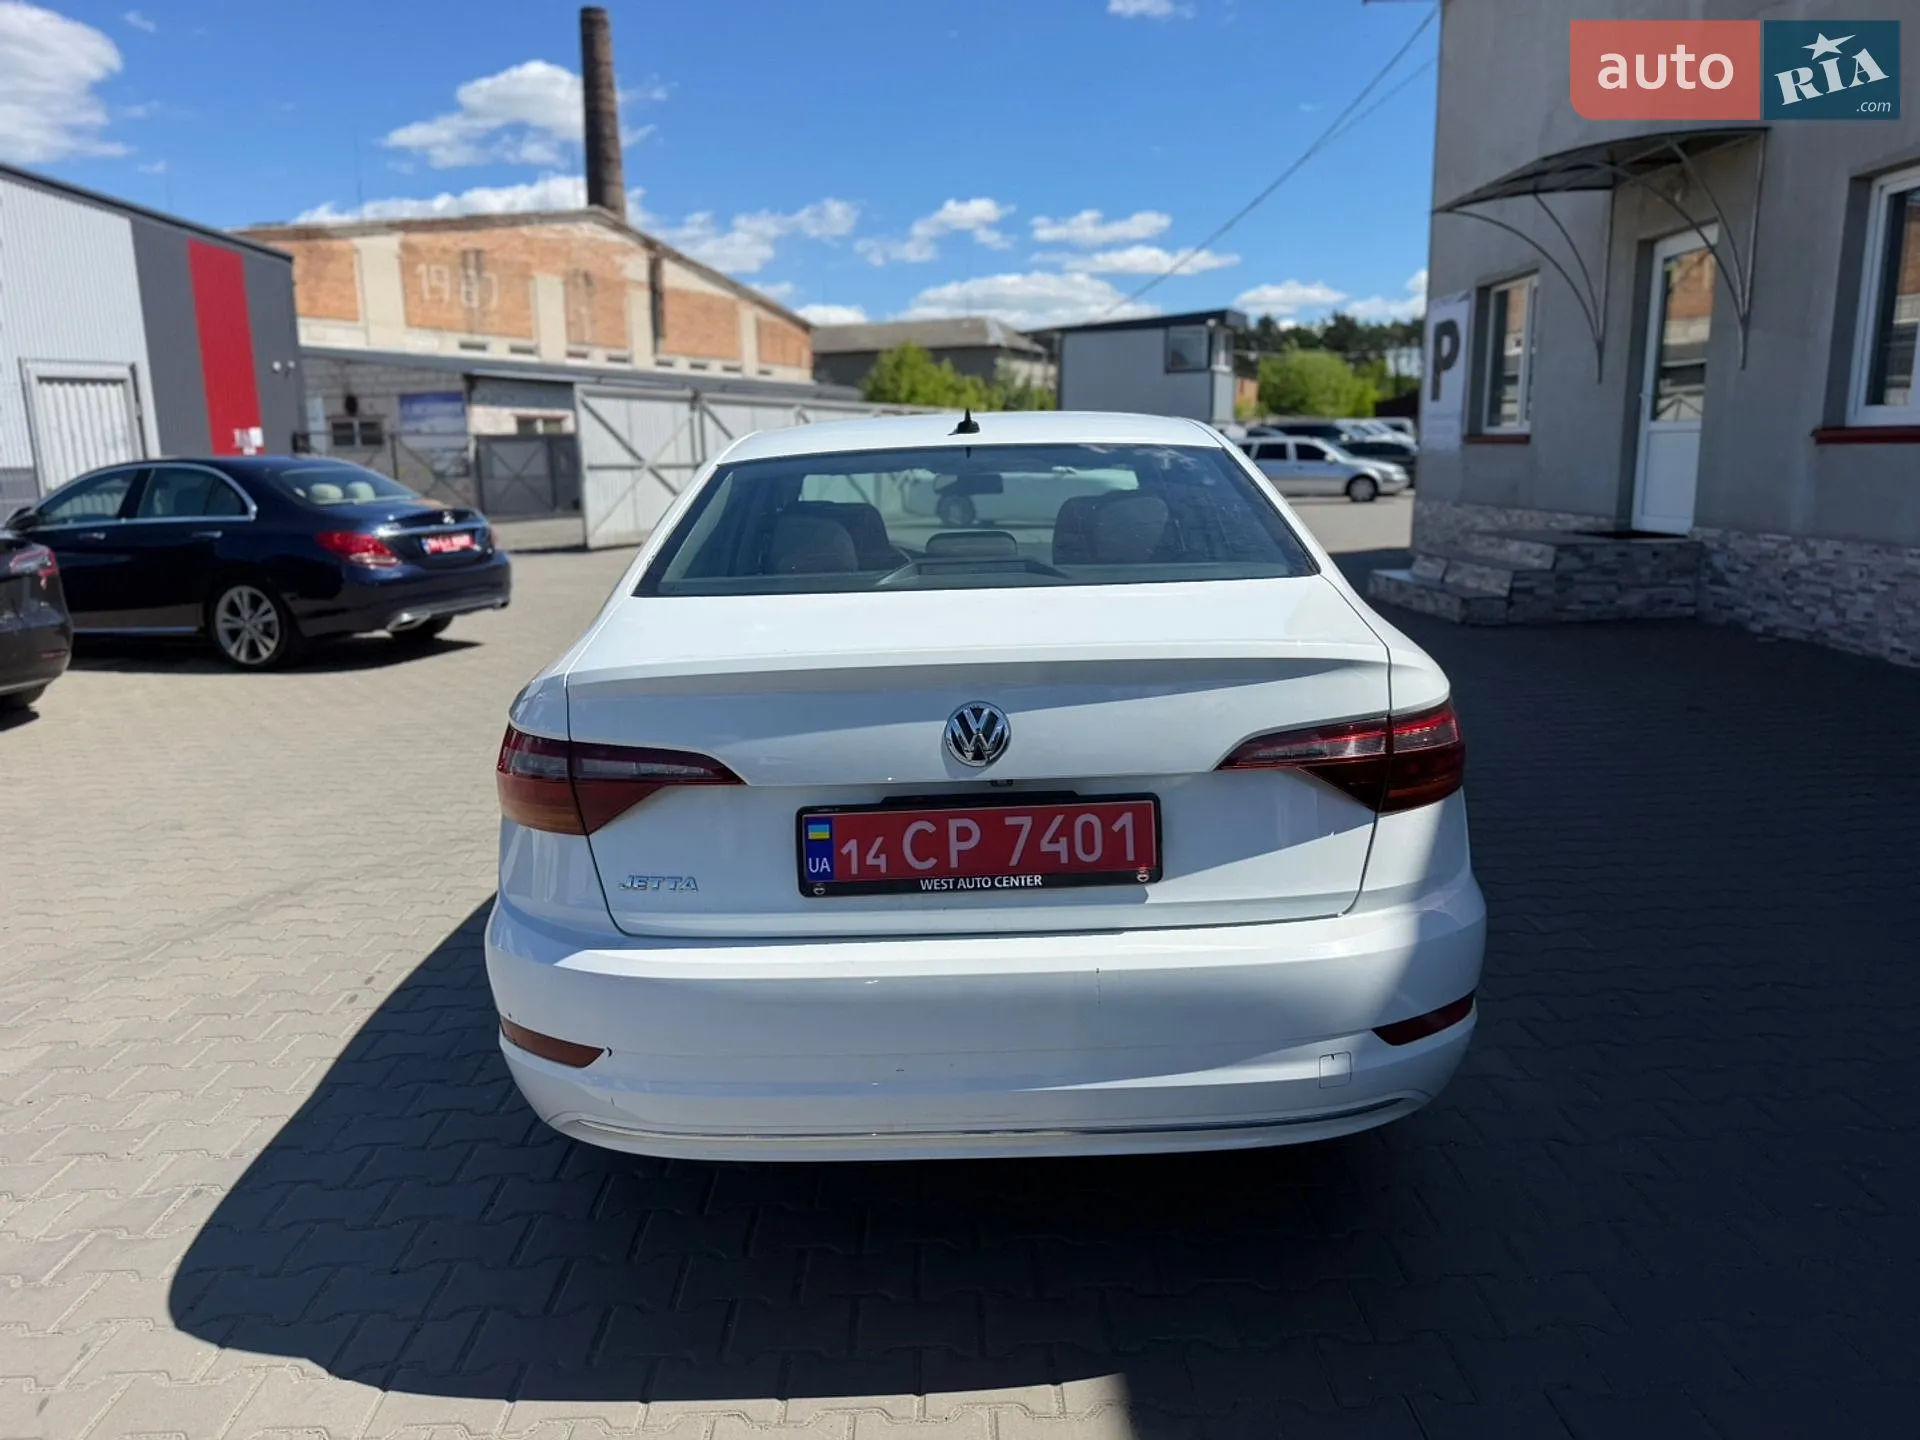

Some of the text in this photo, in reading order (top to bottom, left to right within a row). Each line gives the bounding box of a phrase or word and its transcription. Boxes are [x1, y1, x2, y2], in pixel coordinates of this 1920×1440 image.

[1431, 318, 1460, 402] P
[840, 811, 1135, 875] 14 CP 7401
[808, 857, 831, 873] UA
[619, 874, 699, 892] JETTA
[920, 874, 1043, 890] WEST AUTO CENTER
